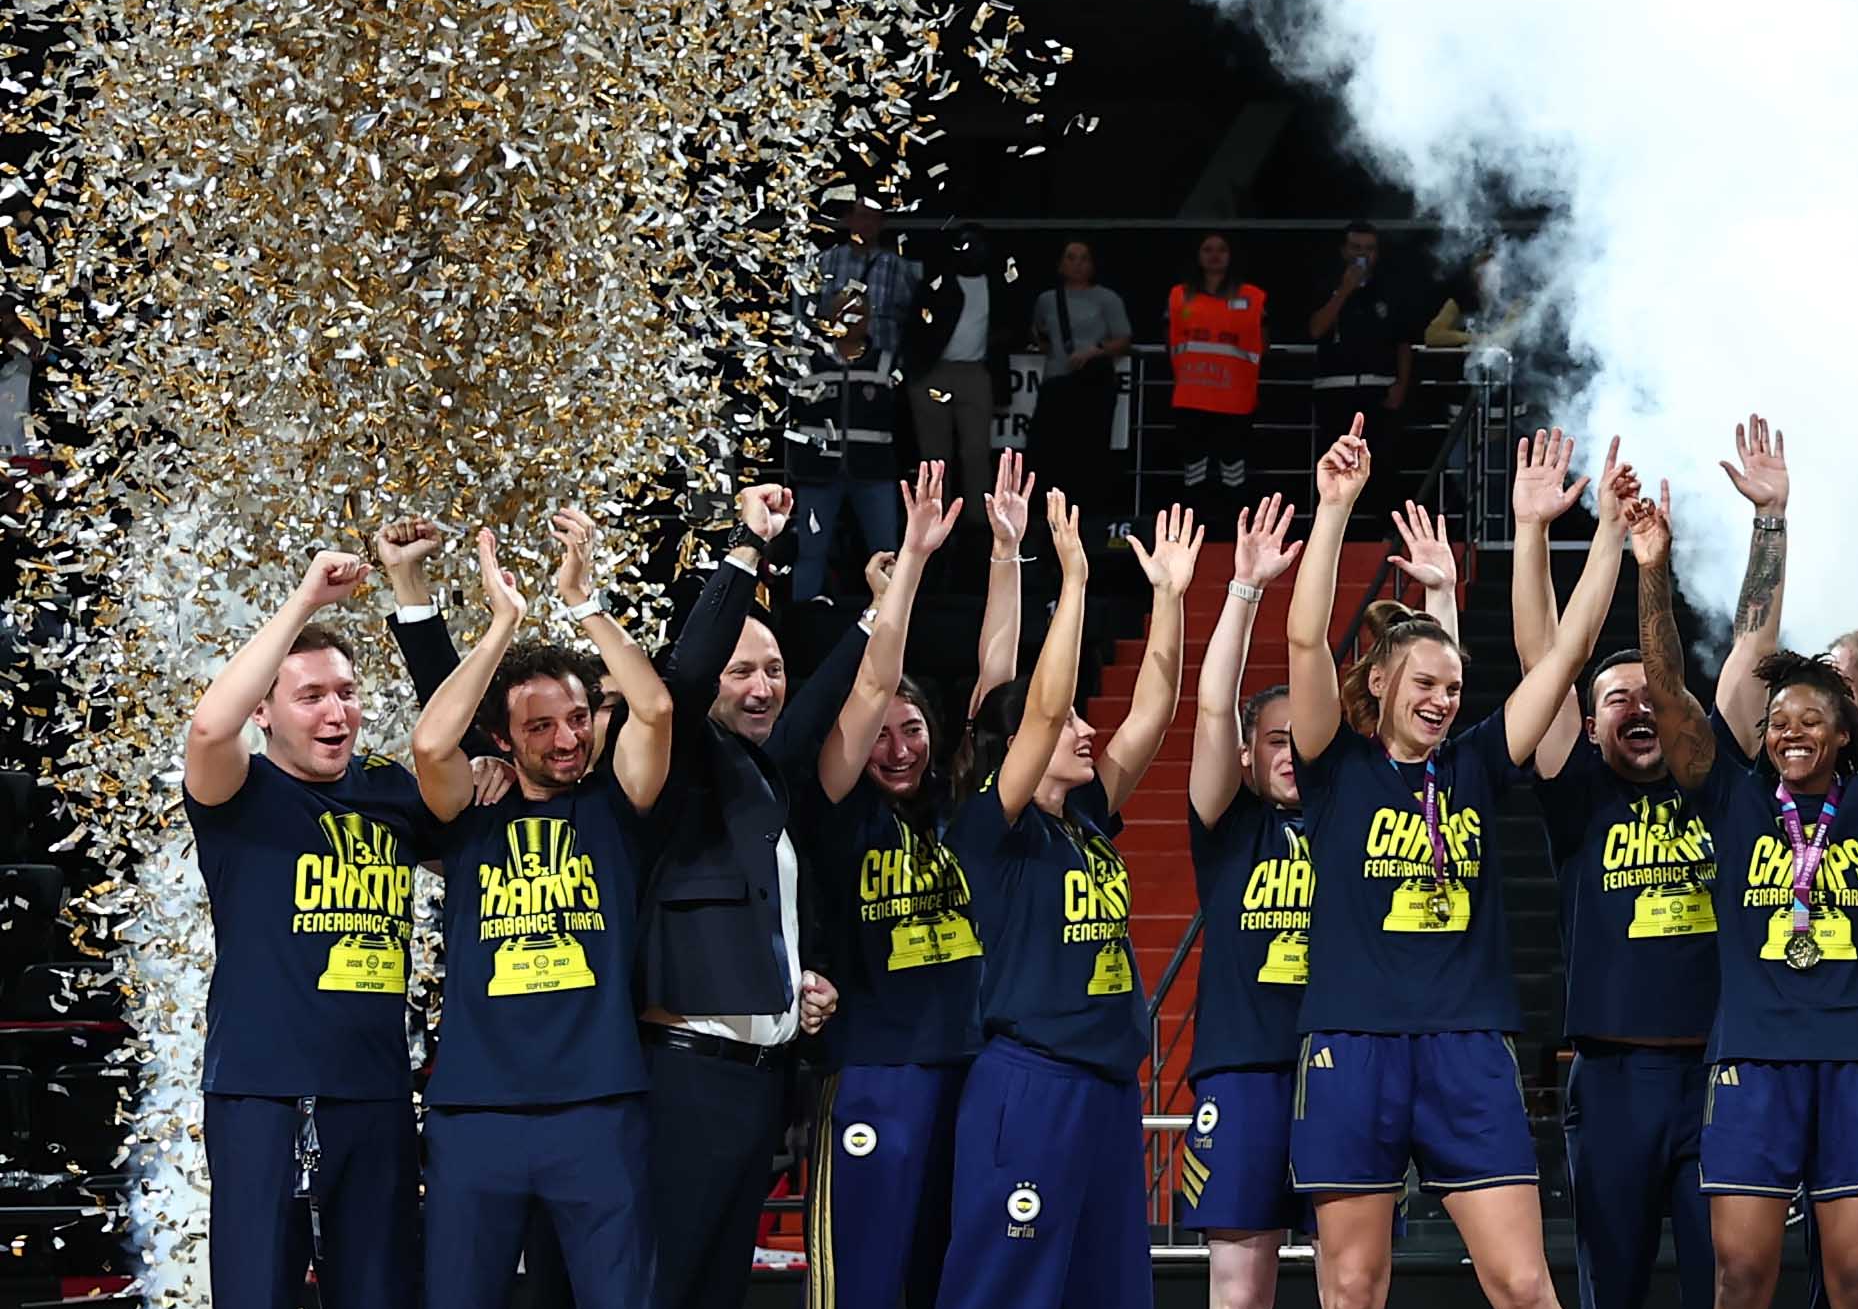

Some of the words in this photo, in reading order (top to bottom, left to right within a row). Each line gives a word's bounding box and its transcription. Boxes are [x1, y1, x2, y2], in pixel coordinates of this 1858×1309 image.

[1107, 522, 1132, 538] 16
[294, 854, 412, 916] CHAMP
[293, 912, 389, 934] FENERBAHÇE
[1241, 910, 1310, 930] FENERBAH
[355, 981, 385, 990] SUPERCUP
